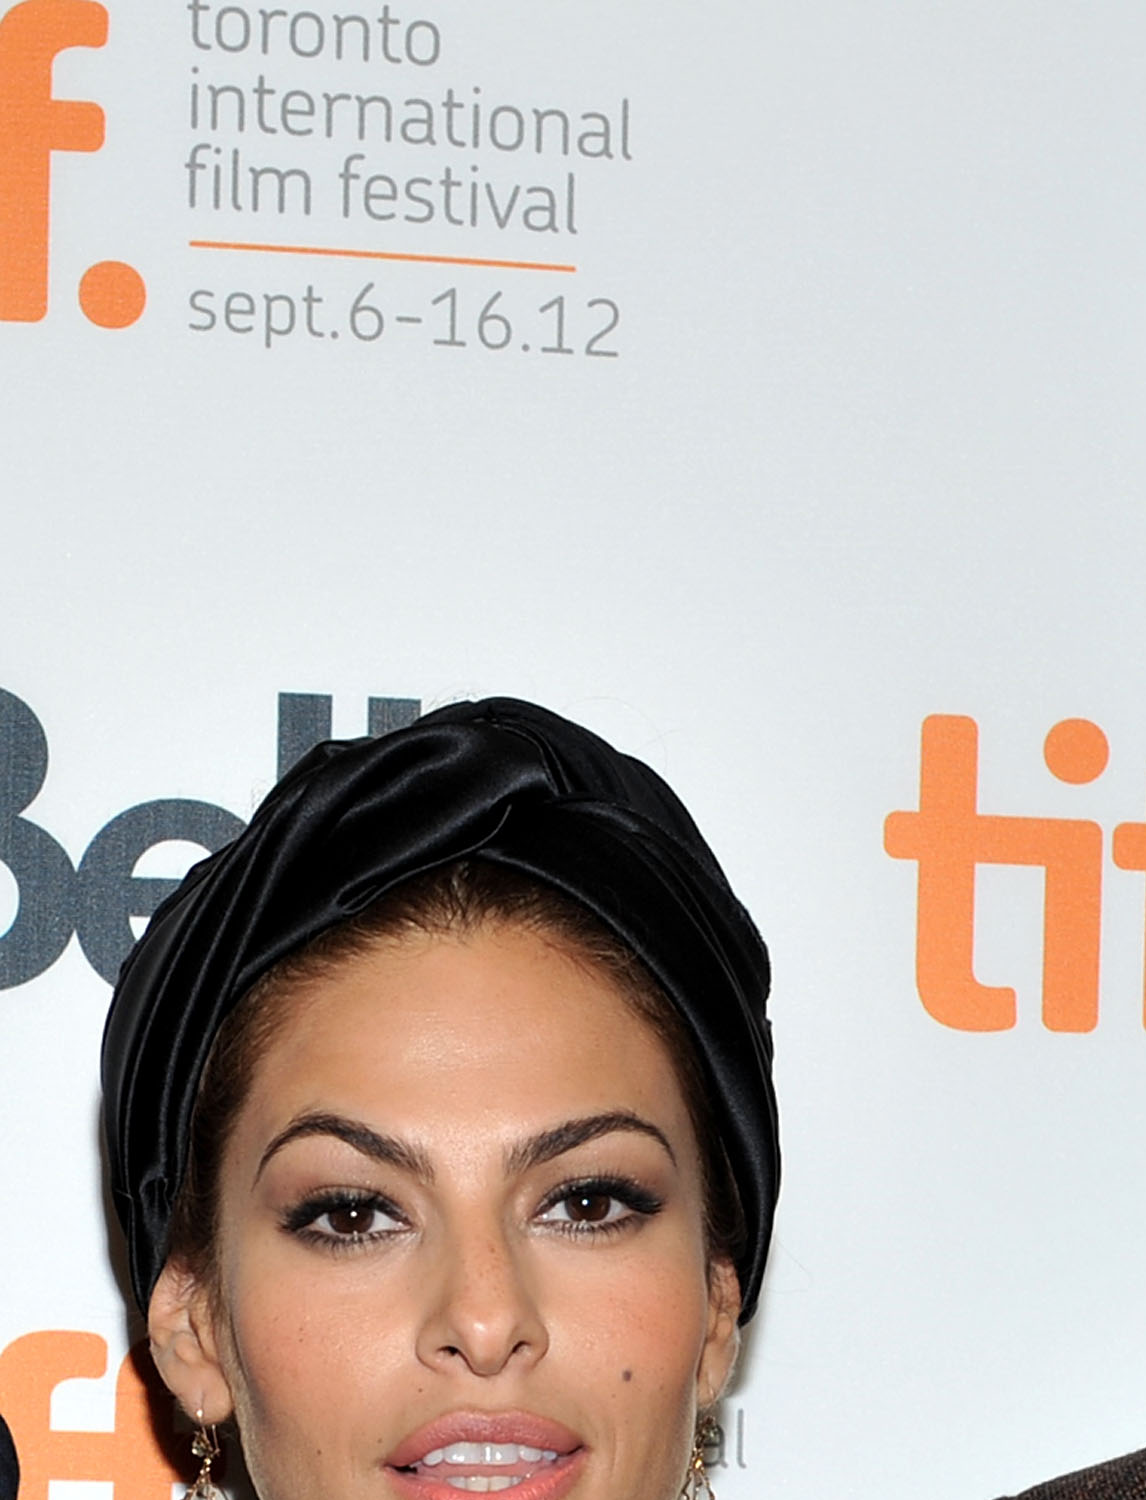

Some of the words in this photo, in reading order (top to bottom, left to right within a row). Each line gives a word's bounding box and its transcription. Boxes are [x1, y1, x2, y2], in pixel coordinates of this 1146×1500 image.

[187, 0, 441, 66] toronto
[189, 66, 633, 161] international
[185, 143, 312, 216] film
[338, 153, 578, 235] festival
[188, 282, 620, 358] sept.6-16.12
